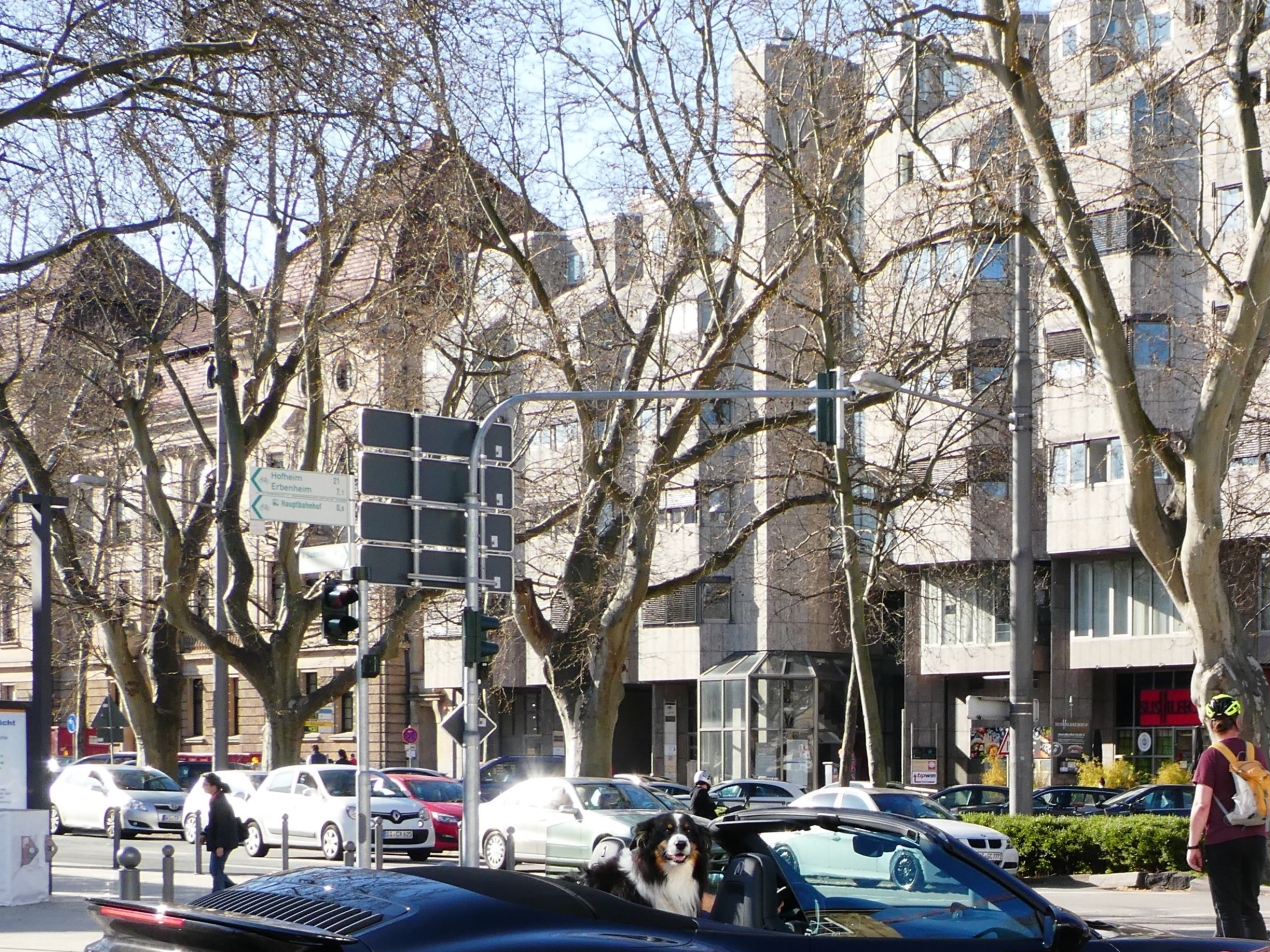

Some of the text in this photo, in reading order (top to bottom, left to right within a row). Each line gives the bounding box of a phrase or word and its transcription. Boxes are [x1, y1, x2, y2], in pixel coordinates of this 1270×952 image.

[271, 472, 303, 482] Hofheim
[271, 483, 312, 493] Erbenheim
[281, 500, 322, 510] Hauptbahnhof
